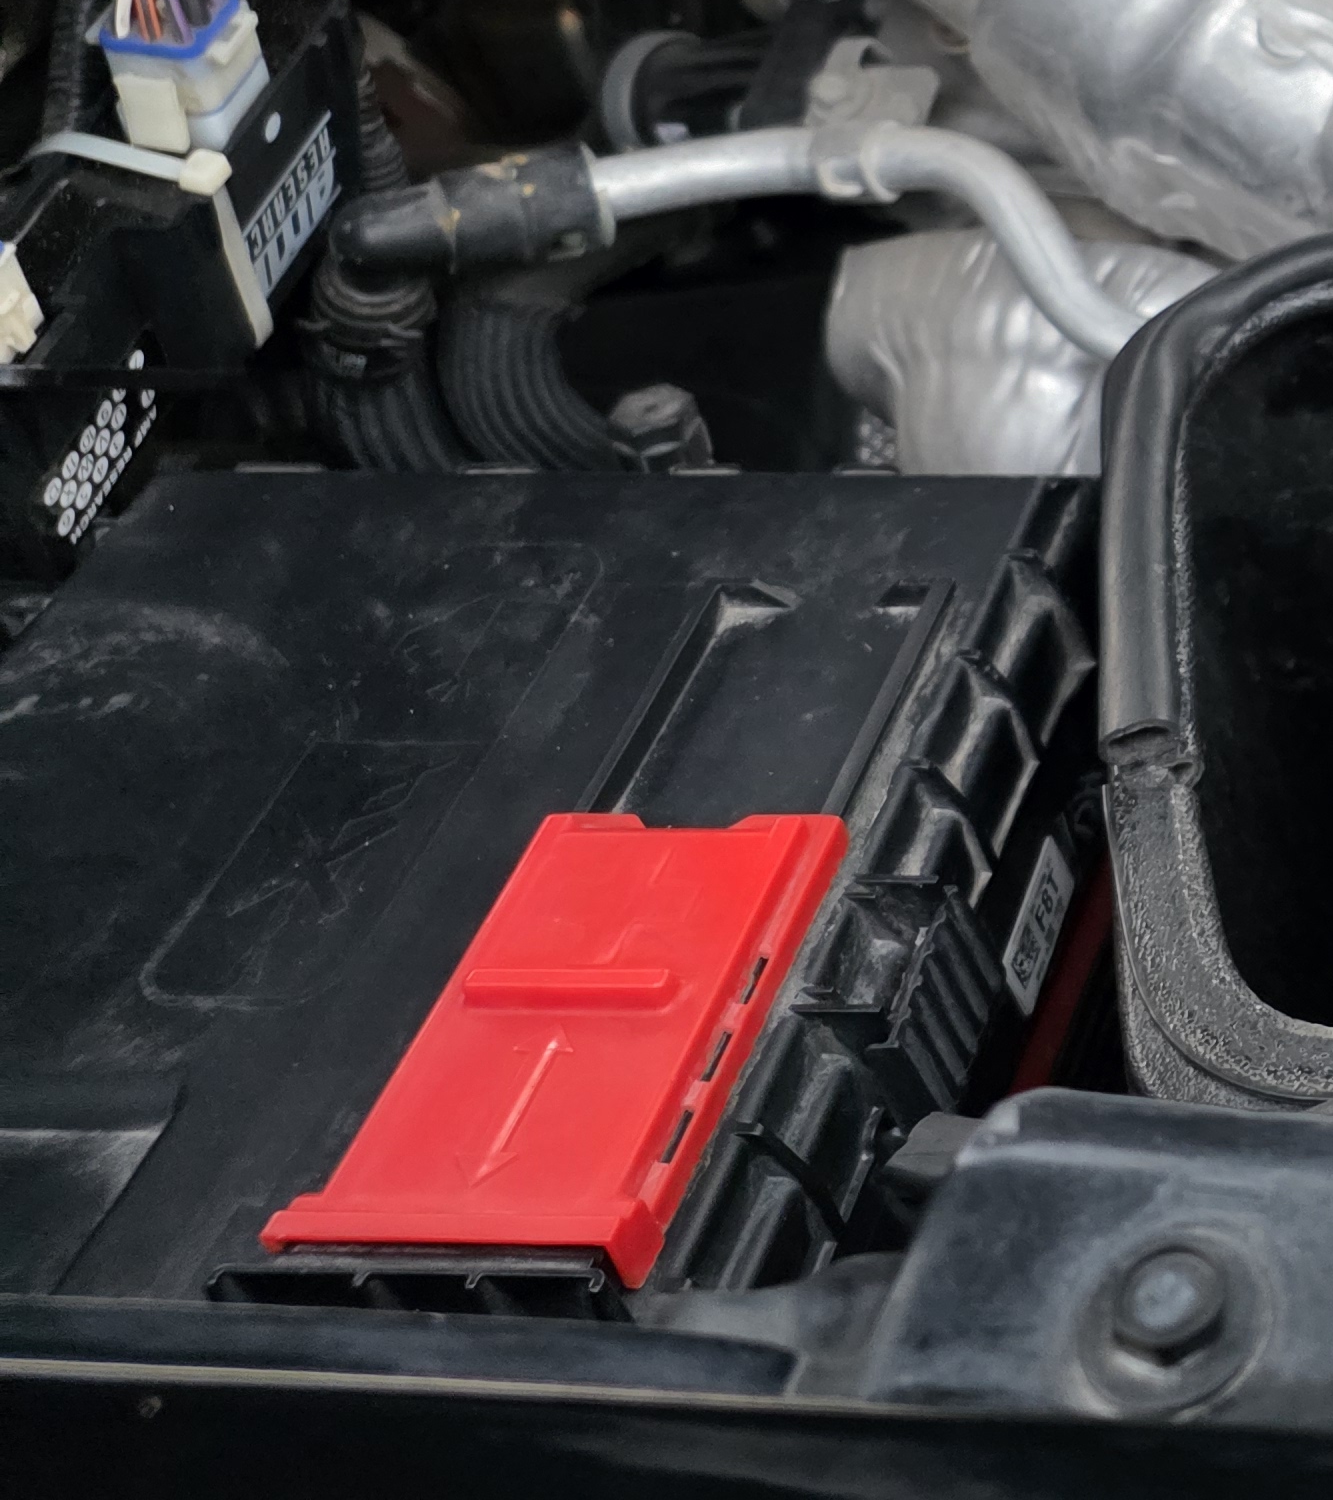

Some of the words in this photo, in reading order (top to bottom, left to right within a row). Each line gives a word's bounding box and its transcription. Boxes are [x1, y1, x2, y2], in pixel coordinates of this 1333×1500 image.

[246, 124, 332, 263] RESEARC
[69, 445, 132, 545] RESEARCH
[1034, 866, 1059, 934] F8T
